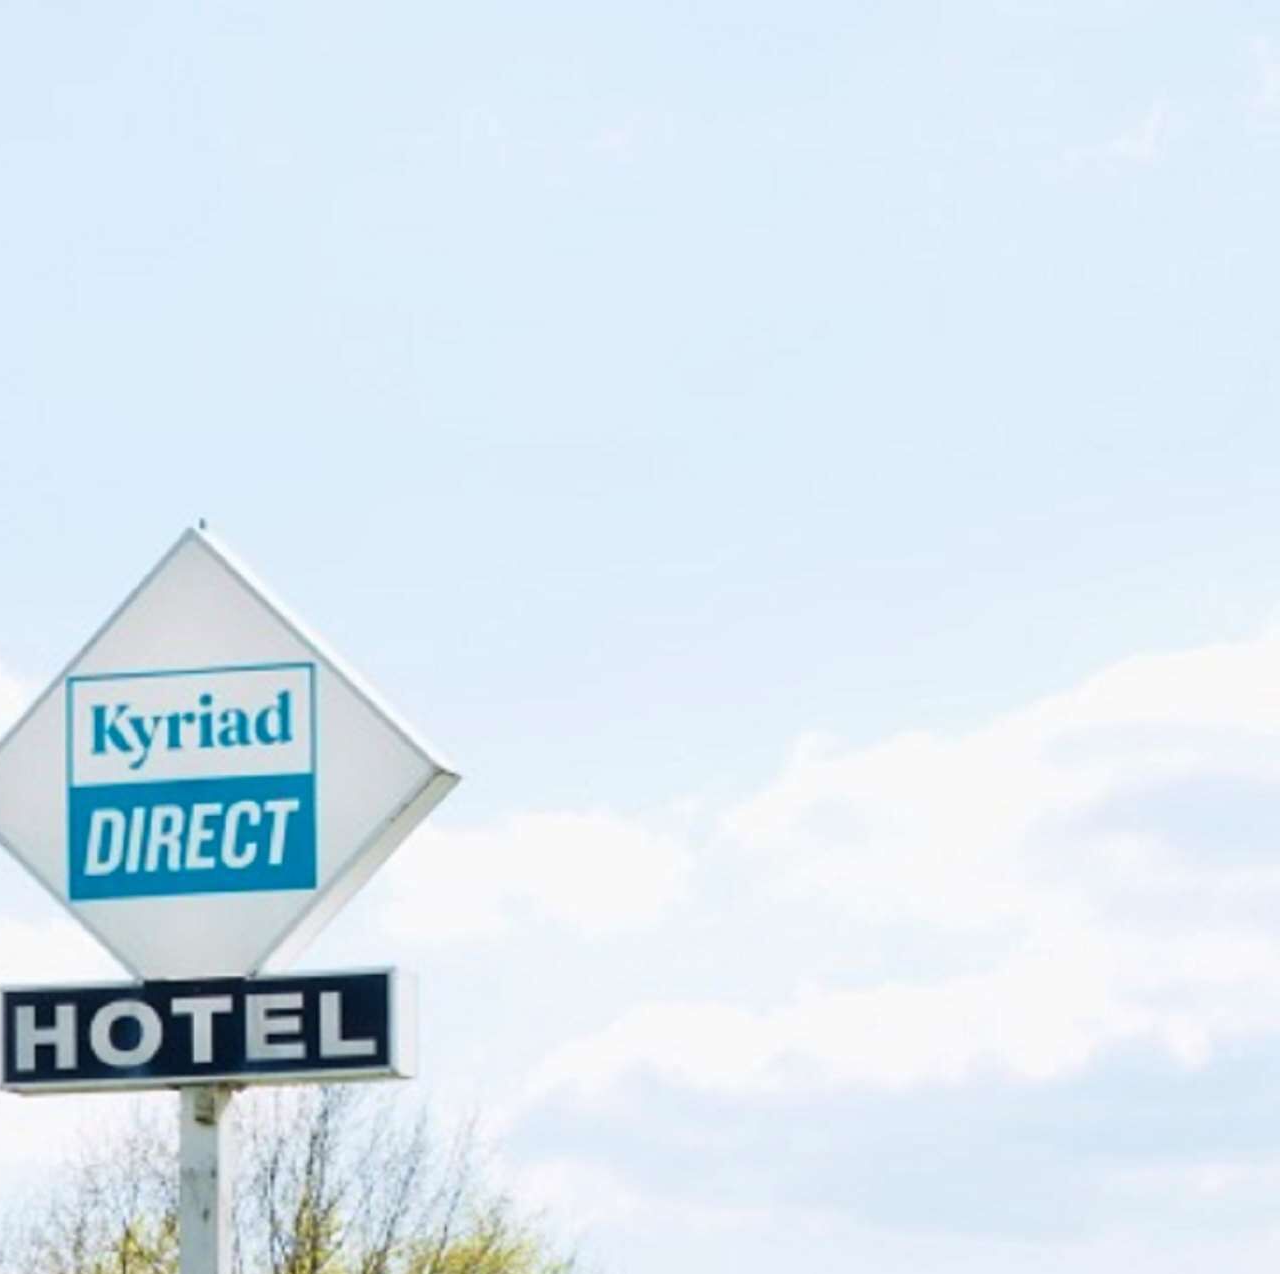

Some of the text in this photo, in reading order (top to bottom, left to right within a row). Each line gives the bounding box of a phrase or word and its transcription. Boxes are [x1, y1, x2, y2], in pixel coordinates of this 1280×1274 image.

[90, 690, 293, 769] Kyriad
[84, 799, 299, 876] DIRECT
[14, 991, 377, 1072] HOTEL
